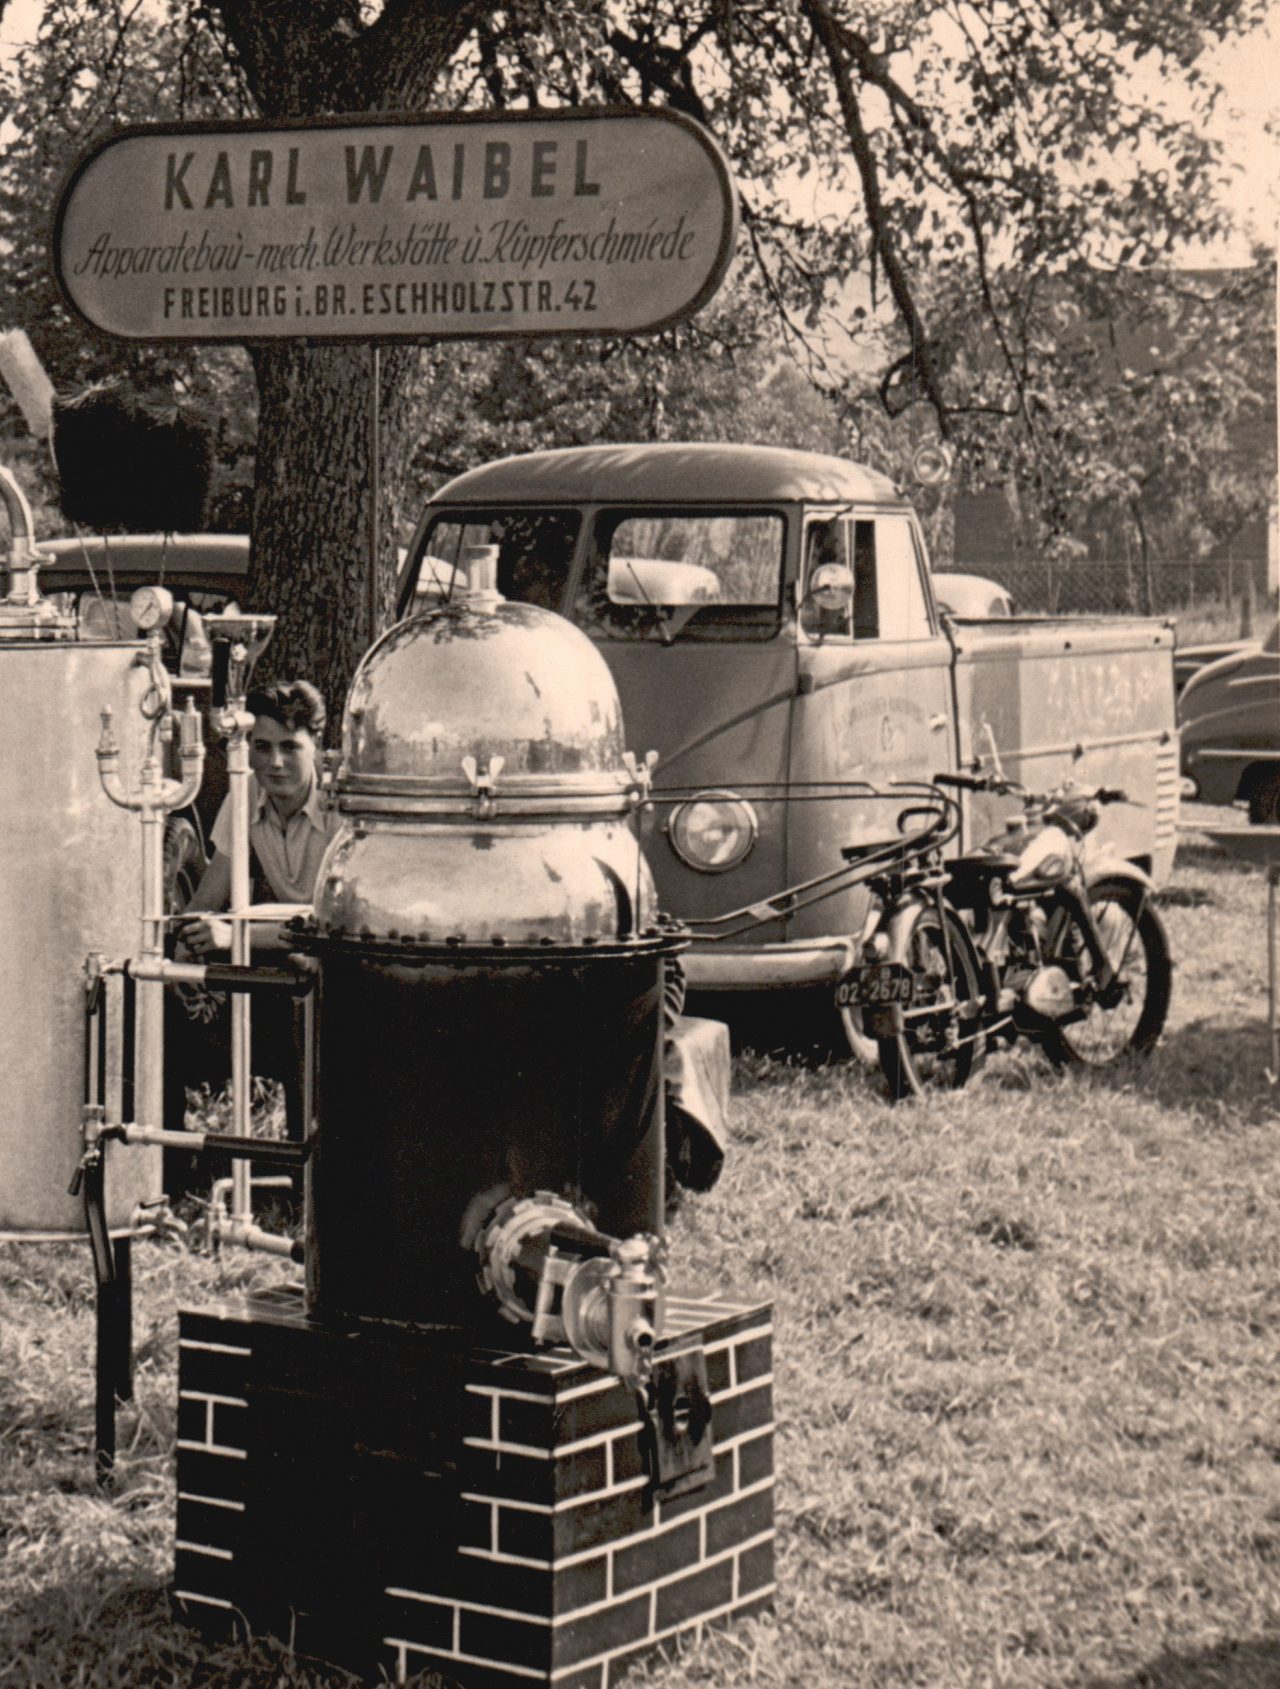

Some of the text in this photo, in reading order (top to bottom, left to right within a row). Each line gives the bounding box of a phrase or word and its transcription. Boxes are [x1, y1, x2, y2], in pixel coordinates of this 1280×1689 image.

[164, 139, 601, 210] KARL WAIBEL
[164, 285, 287, 319] FREIBURG
